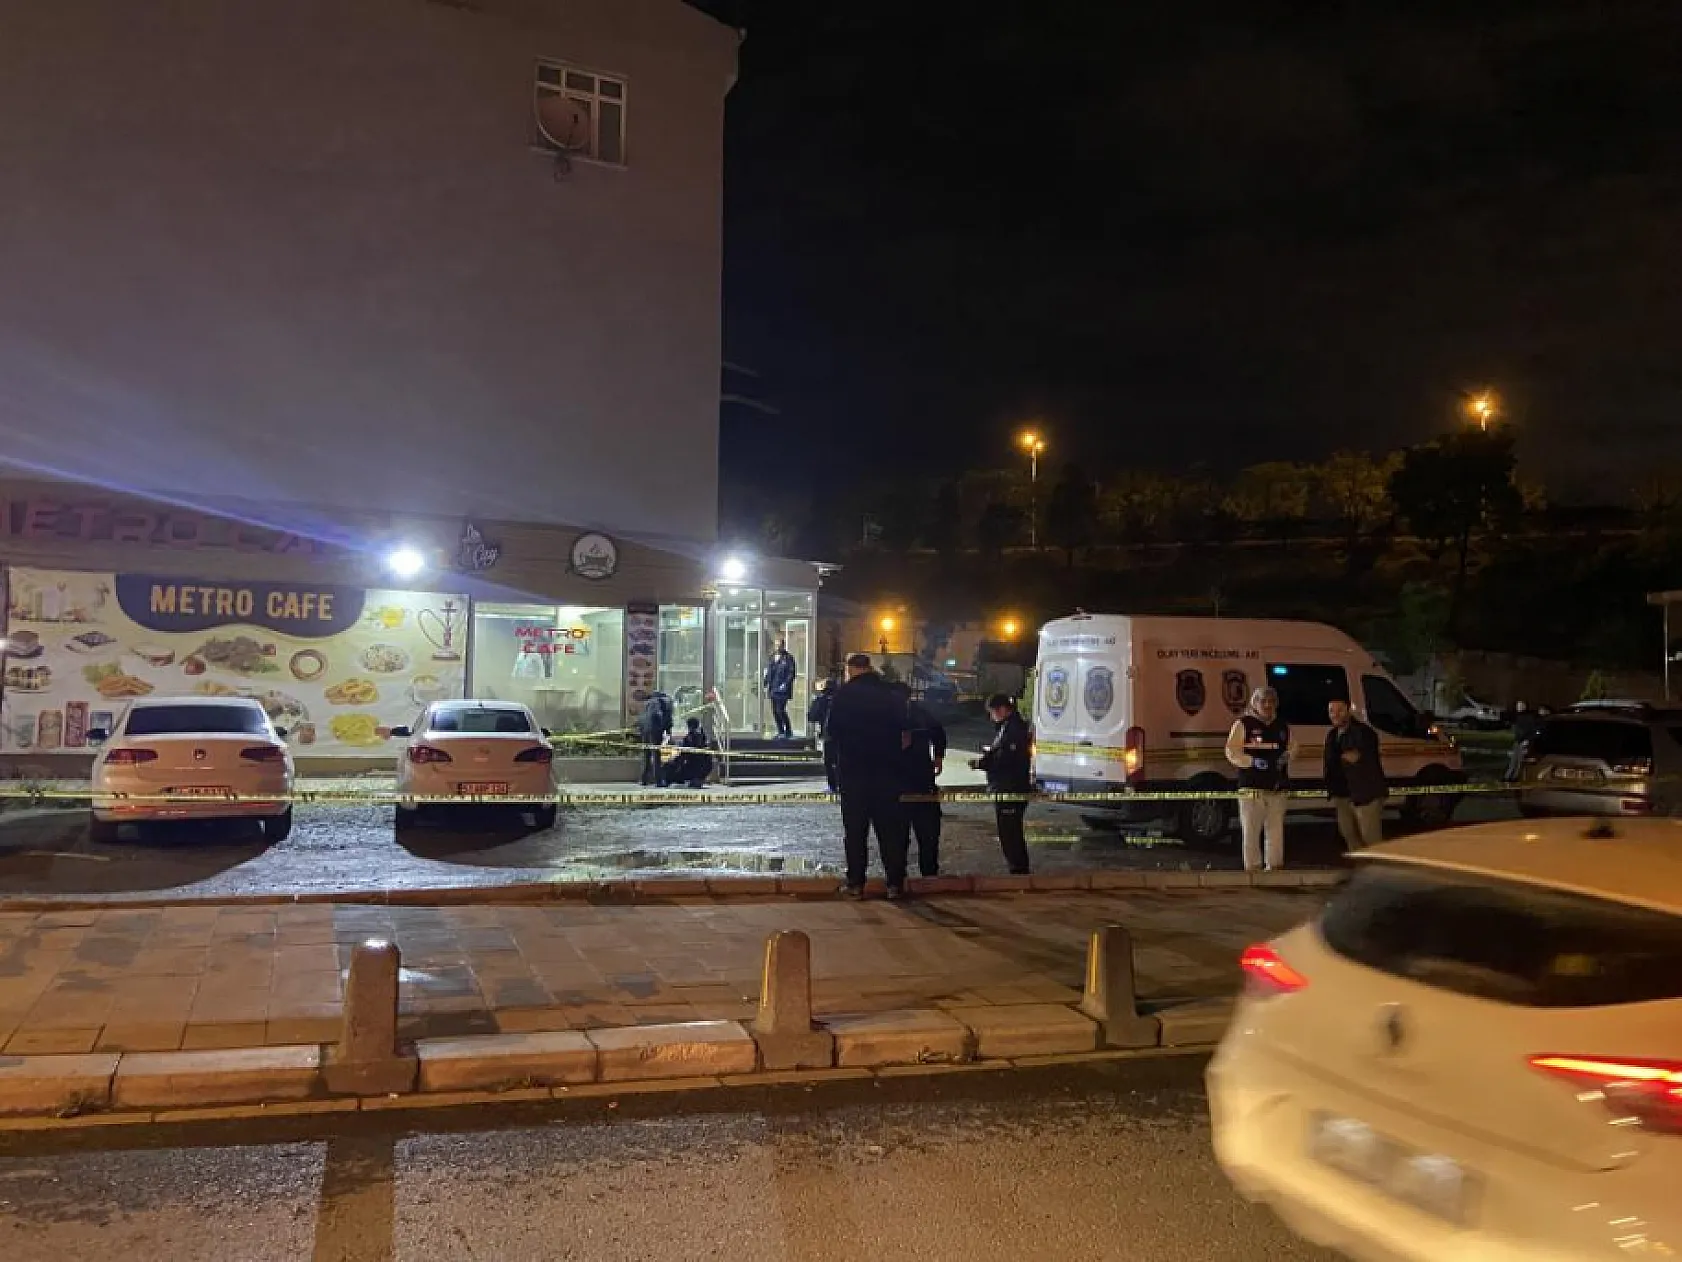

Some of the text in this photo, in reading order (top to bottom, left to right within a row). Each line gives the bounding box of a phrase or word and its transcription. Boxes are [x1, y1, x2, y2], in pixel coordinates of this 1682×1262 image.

[151, 584, 333, 621] METRO CAFE
[514, 626, 586, 640] METRO
[522, 643, 575, 654] CAFE
